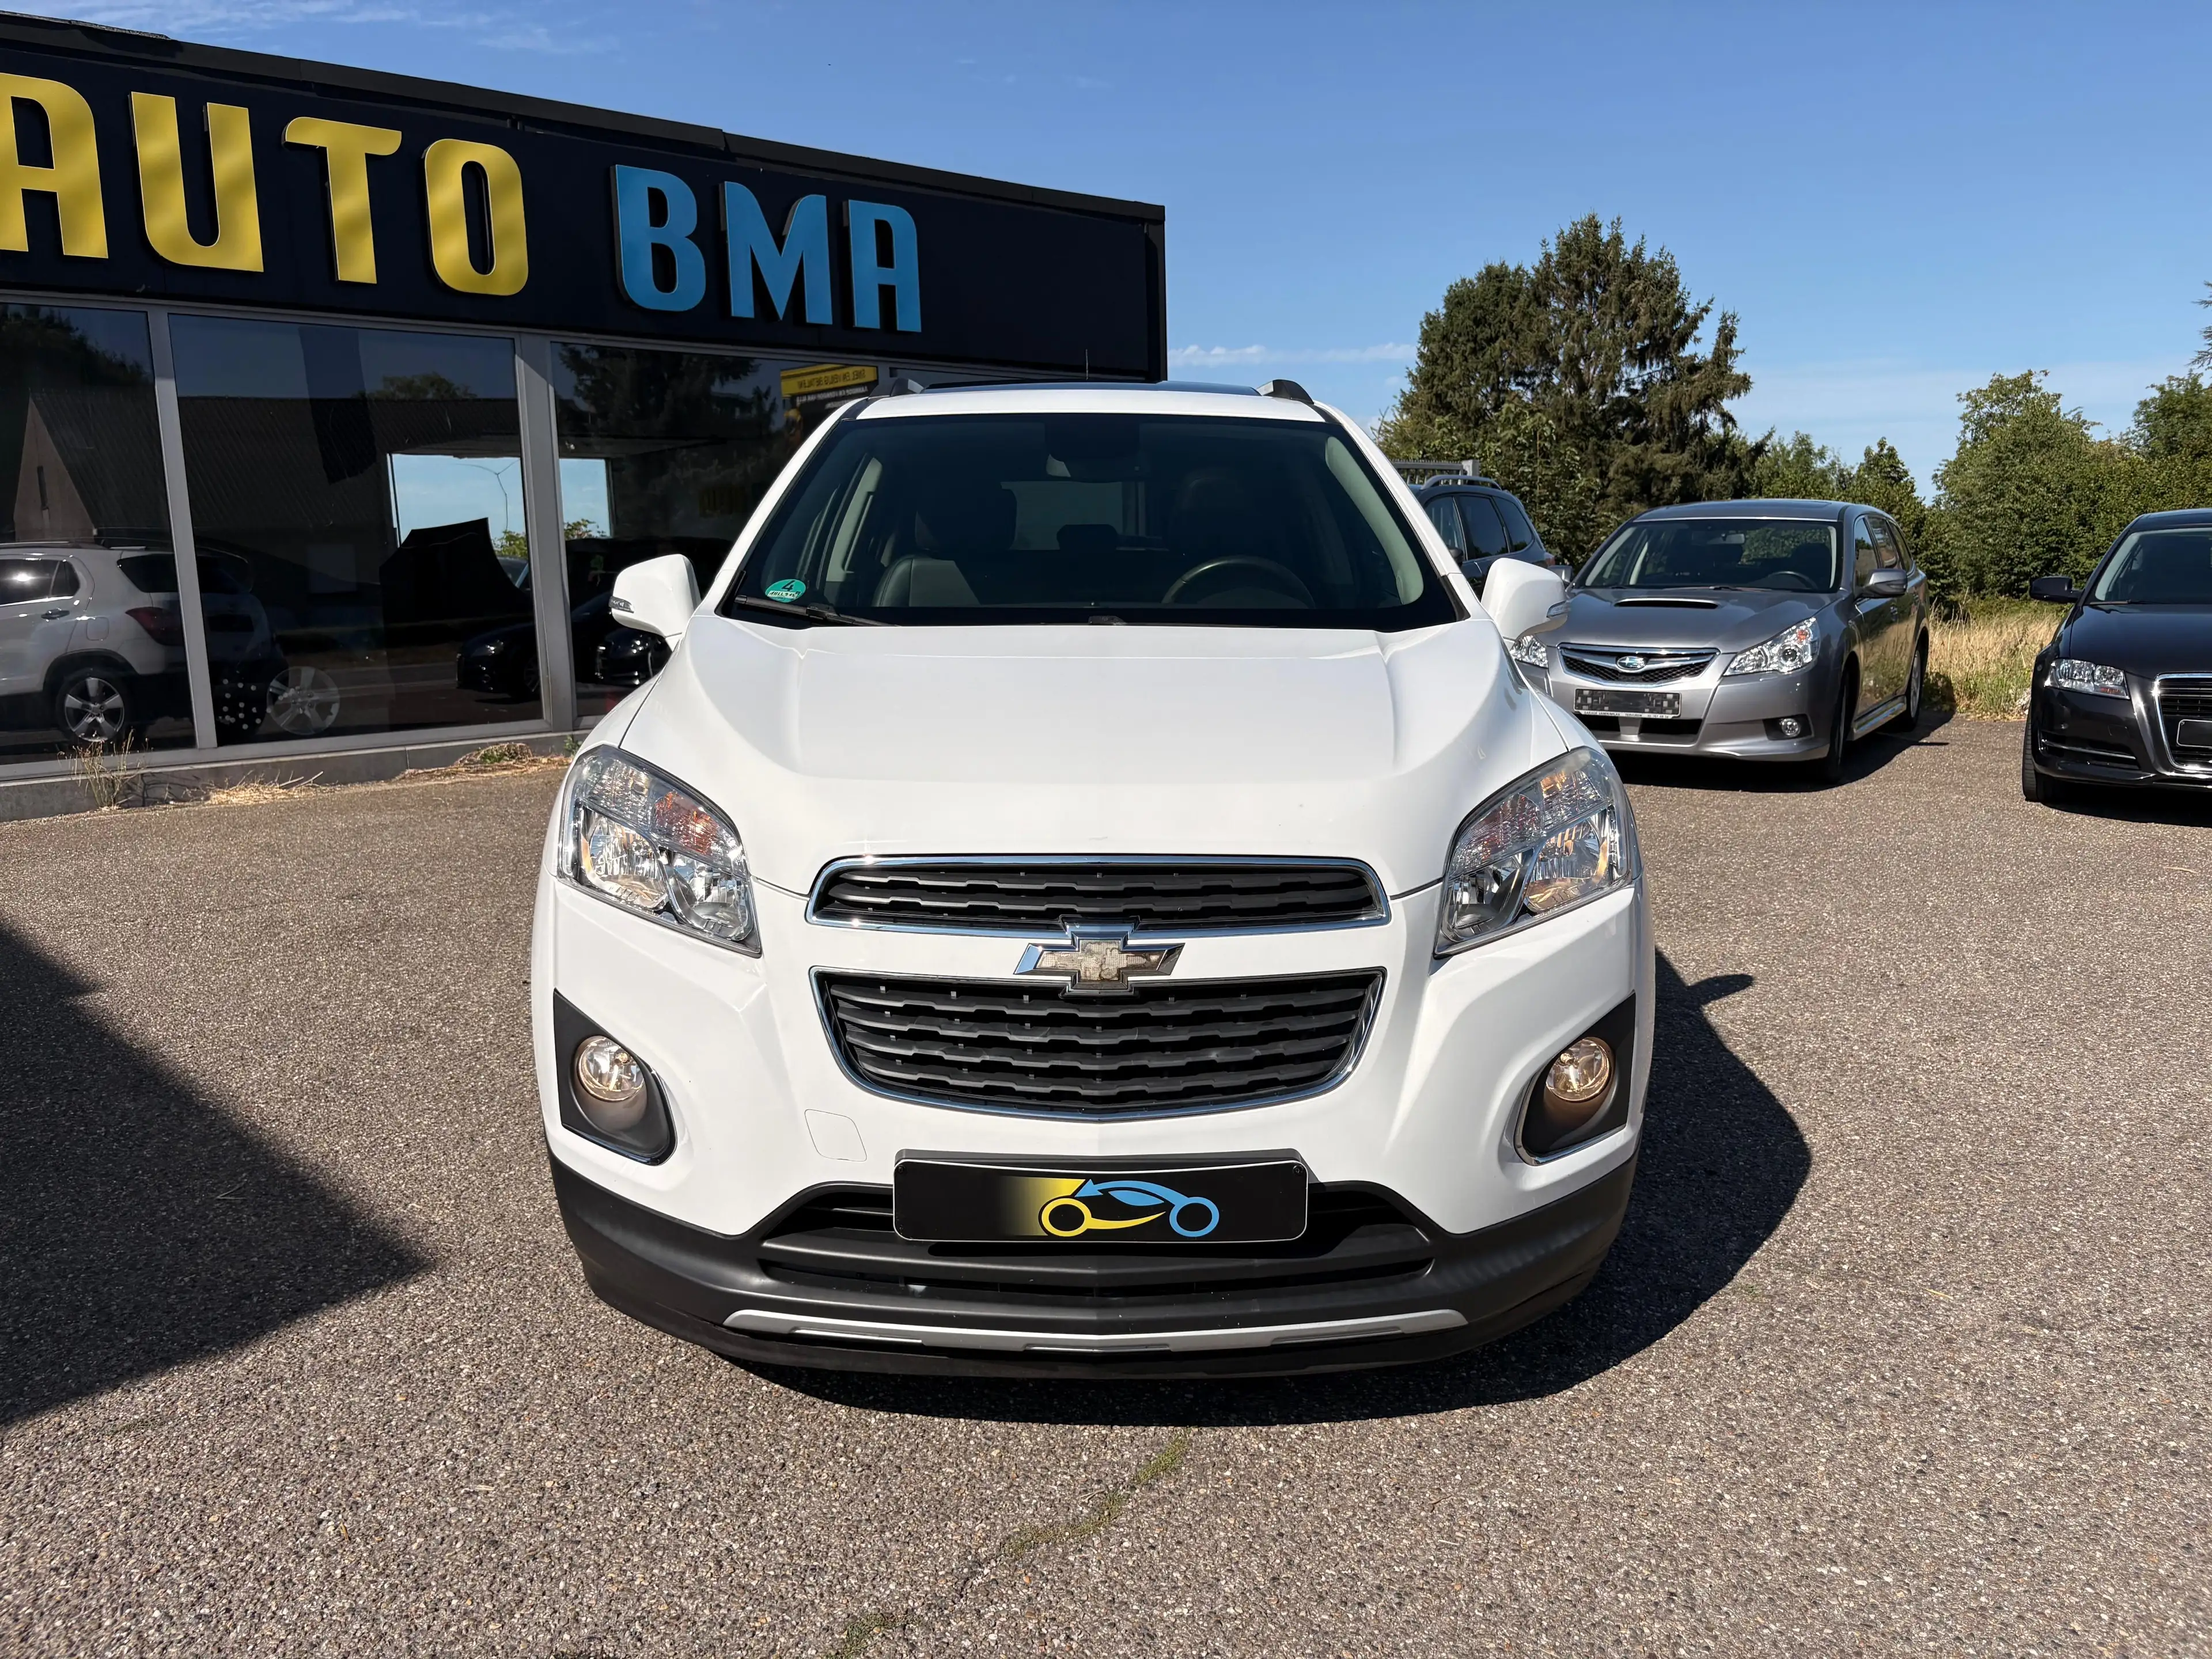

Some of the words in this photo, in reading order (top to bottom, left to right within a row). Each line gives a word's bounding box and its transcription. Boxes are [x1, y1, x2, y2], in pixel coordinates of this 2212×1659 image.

[0, 72, 529, 297] AUTO
[611, 164, 922, 332] BMA
[781, 579, 796, 592] 4
